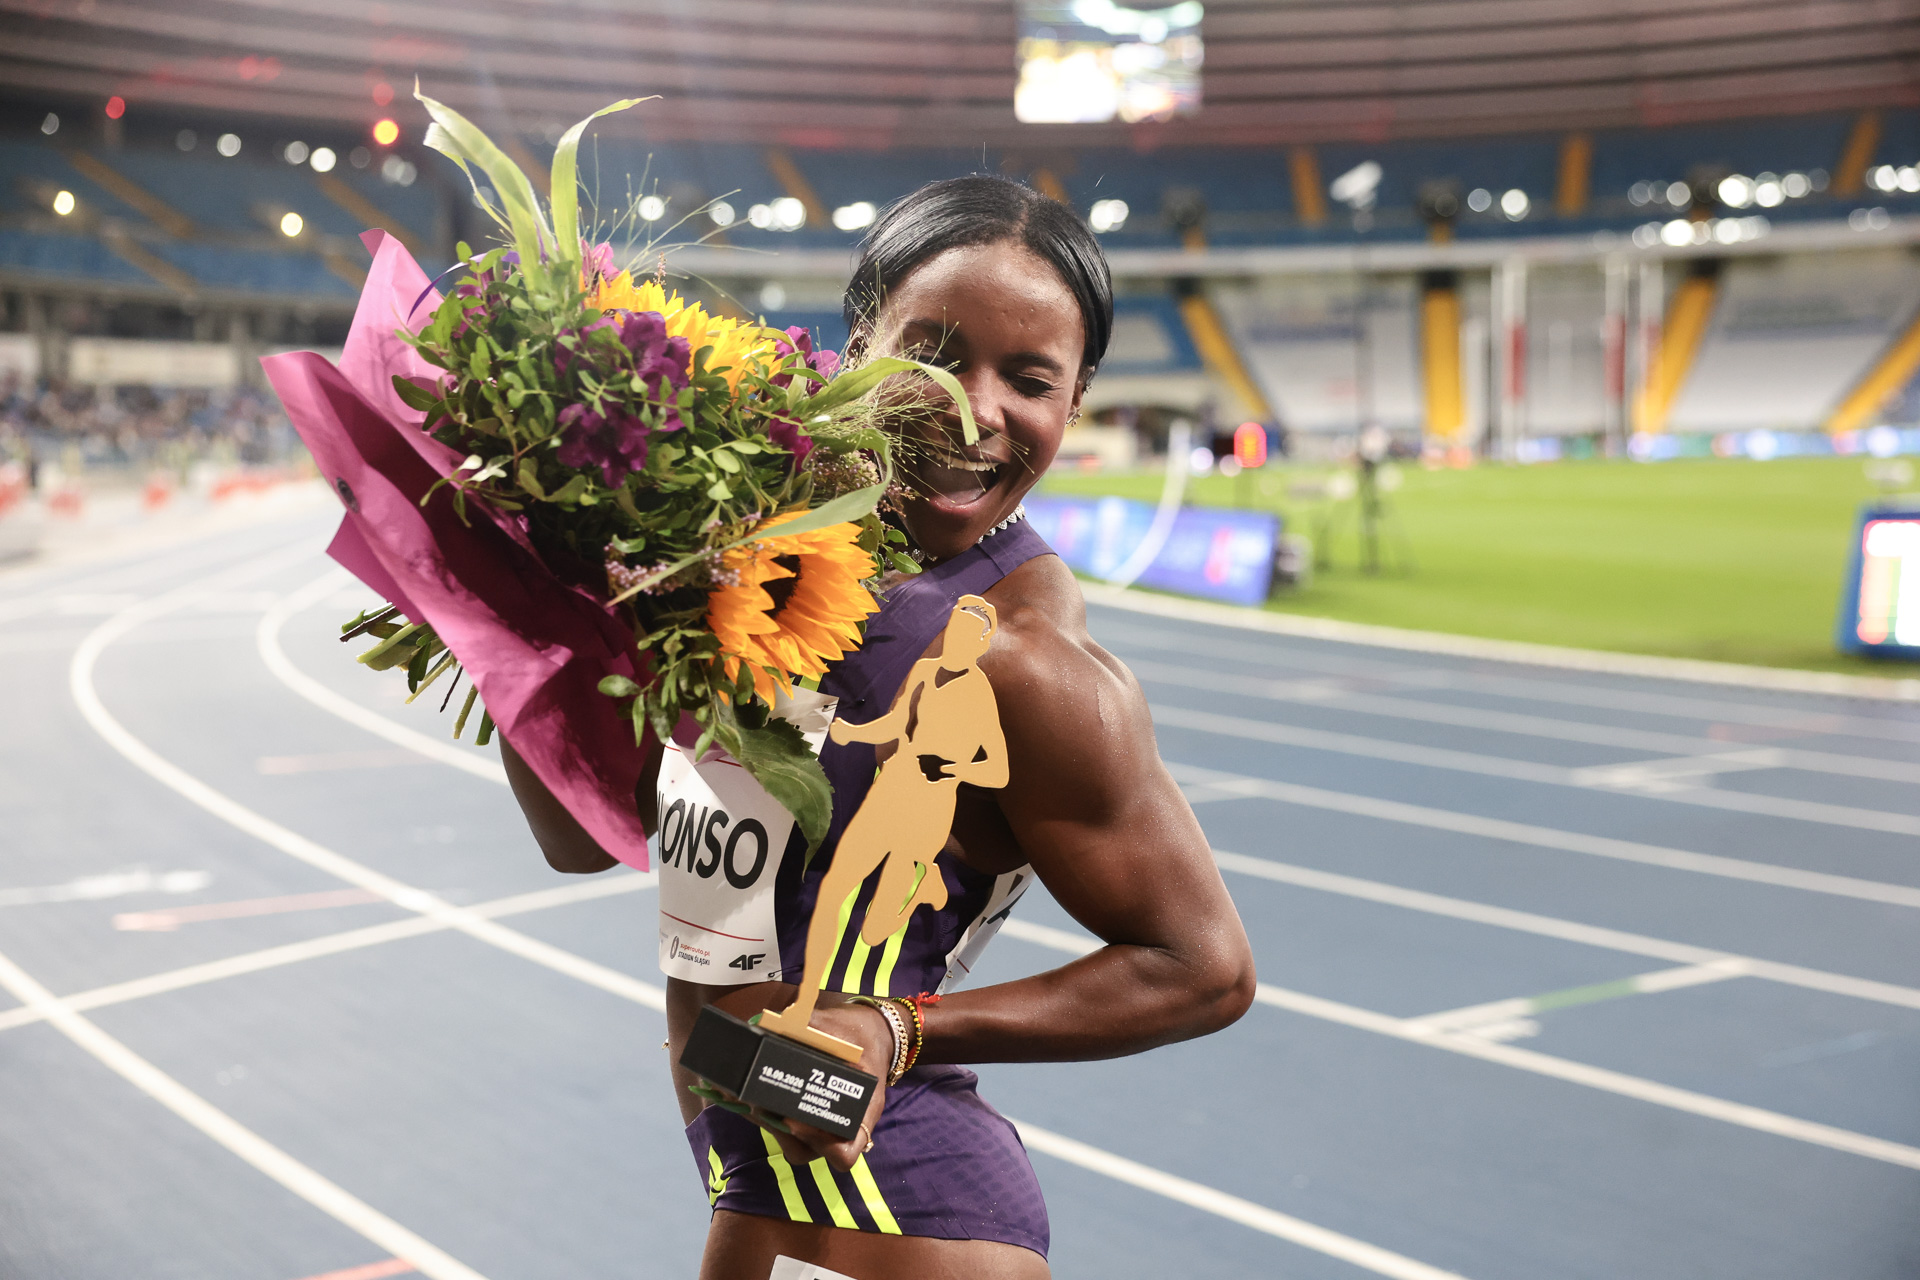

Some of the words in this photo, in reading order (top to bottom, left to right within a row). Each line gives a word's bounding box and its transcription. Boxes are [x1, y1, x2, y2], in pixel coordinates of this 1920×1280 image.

[728, 953, 766, 970] 4F
[809, 1068, 825, 1086] 72.
[831, 1079, 861, 1096] ORLEN
[801, 1092, 831, 1109] JANUSZA
